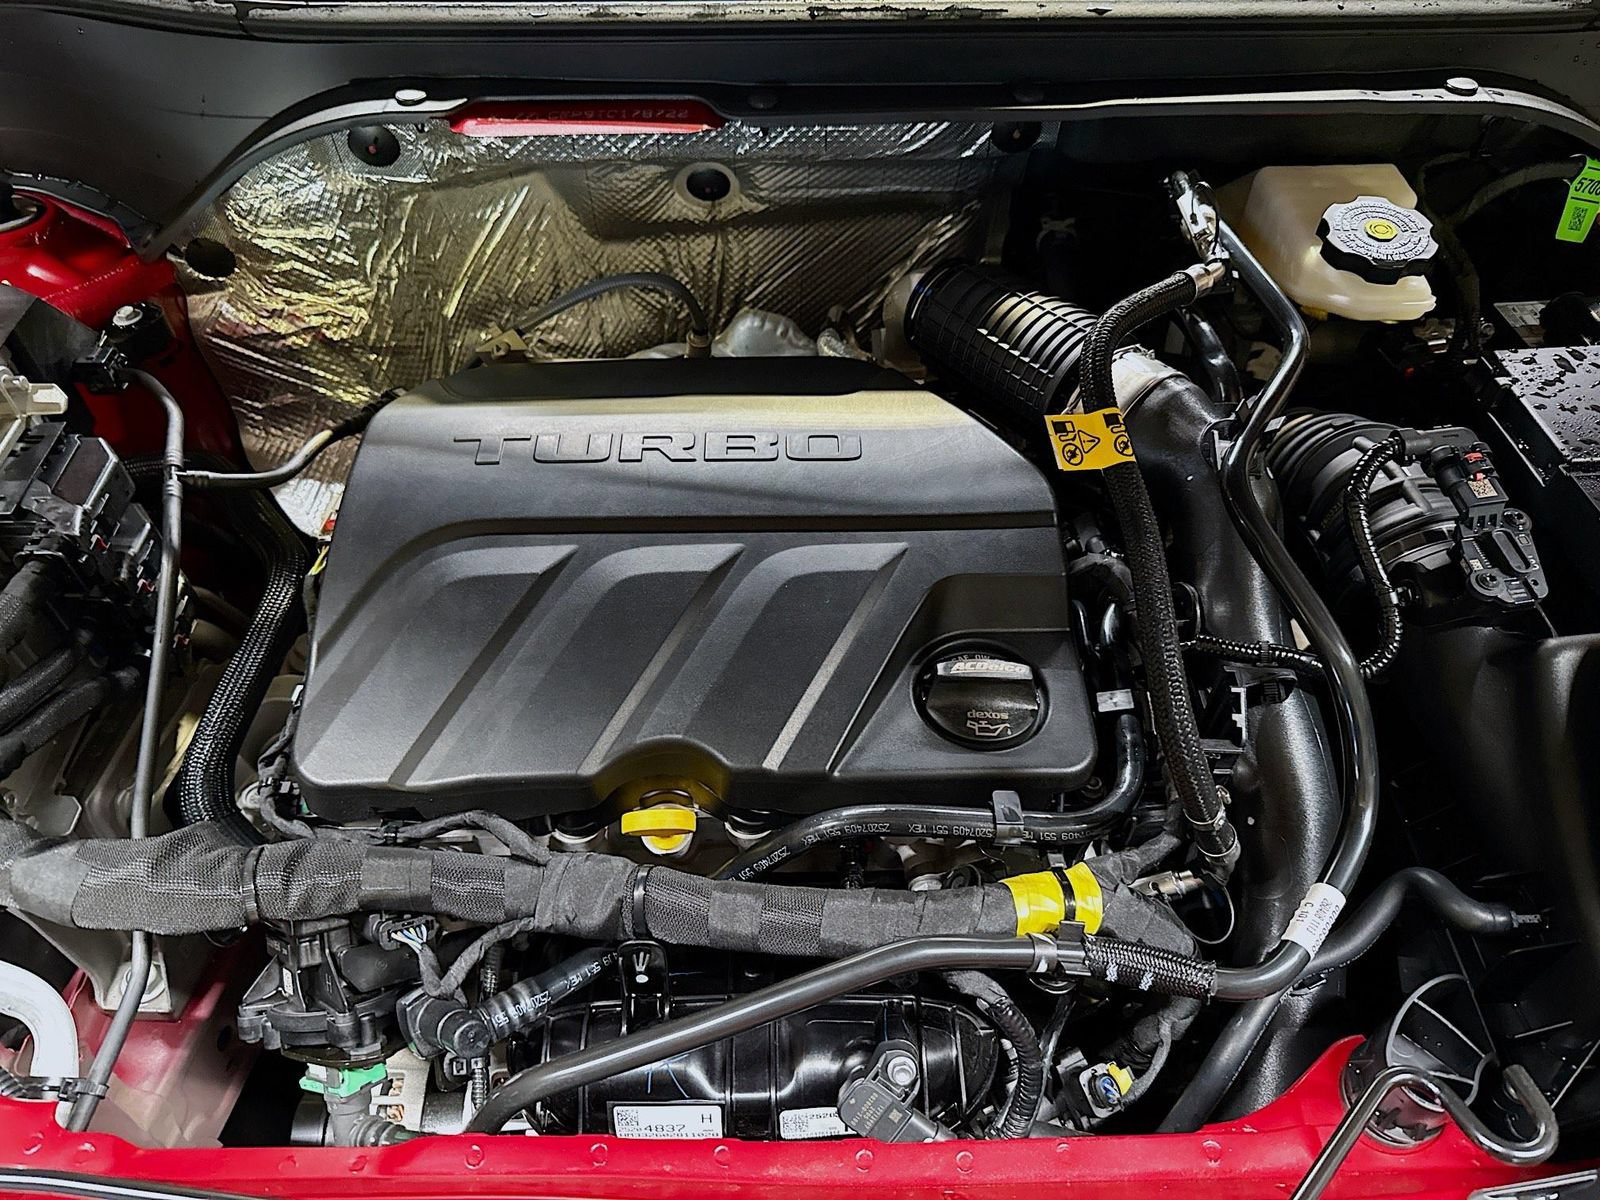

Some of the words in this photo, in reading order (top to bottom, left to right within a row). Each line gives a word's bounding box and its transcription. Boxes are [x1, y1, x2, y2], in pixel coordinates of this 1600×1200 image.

[453, 431, 863, 466] TURBO
[950, 661, 1027, 674] ACDelco
[967, 709, 1009, 720] dexos
[823, 828, 841, 839] 551
[845, 823, 891, 834] 25207409
[908, 823, 927, 834] MEX
[932, 824, 949, 835] 551
[1022, 829, 1034, 839] ME
[801, 833, 820, 846] MEX
[1039, 831, 1057, 841] 551
[753, 845, 791, 873] 25207409
[738, 867, 755, 881] 551
[584, 961, 602, 977] 551
[564, 972, 583, 989] MEX
[491, 1010, 510, 1028] 551
[701, 1113, 712, 1124] H
[644, 1123, 686, 1133] 4837
